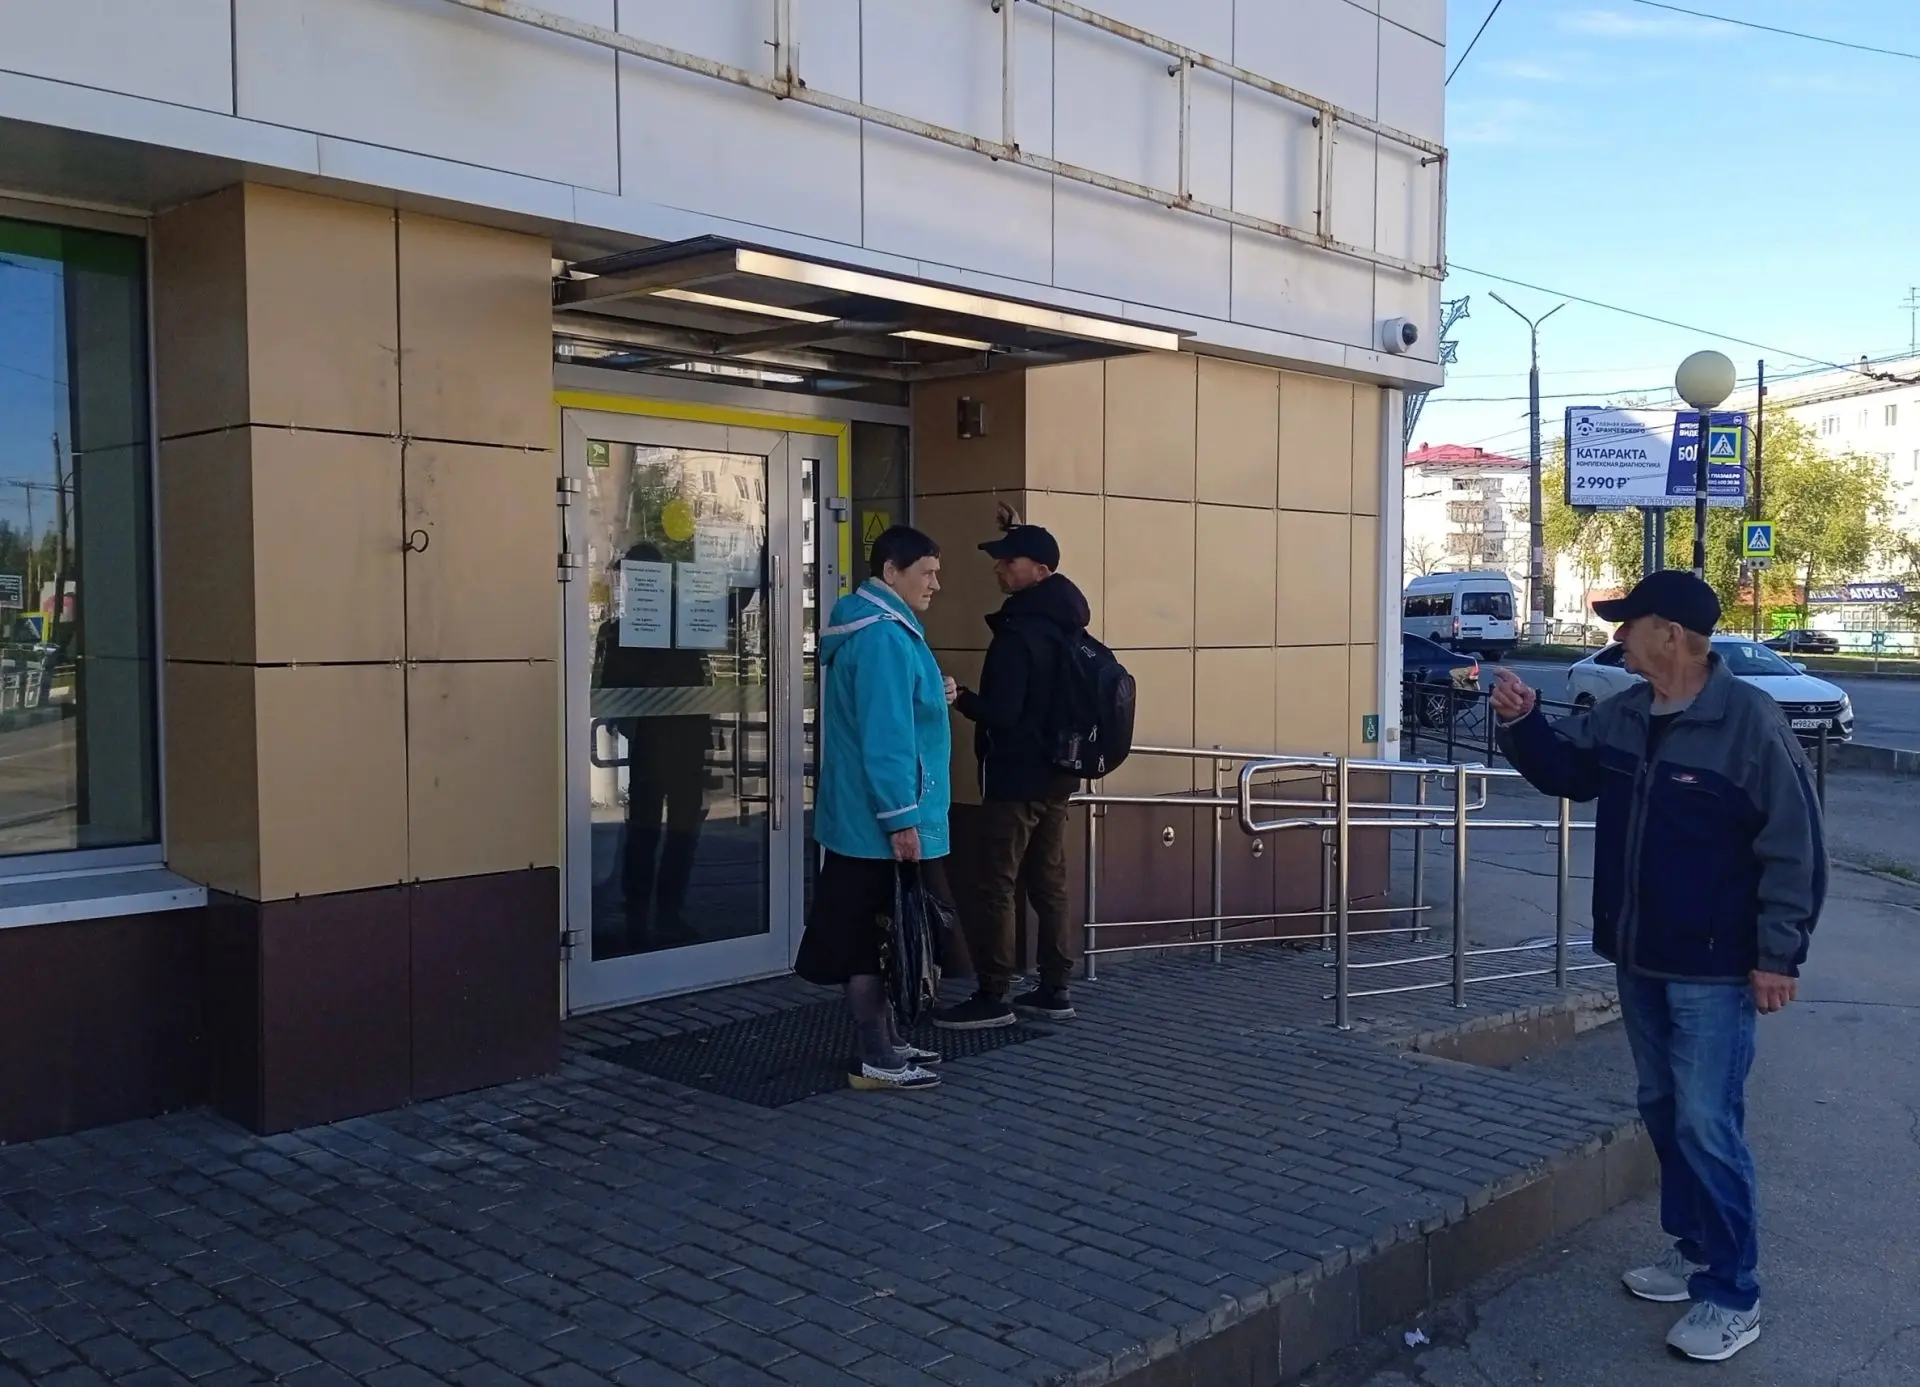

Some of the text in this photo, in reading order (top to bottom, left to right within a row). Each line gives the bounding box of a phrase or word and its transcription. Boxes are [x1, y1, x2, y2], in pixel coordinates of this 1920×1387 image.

[1679, 429, 1699, 437] ВИДЕ
[1577, 448, 1647, 460] КАТАРАКТА
[1678, 443, 1699, 461] БОЛ
[1576, 460, 1661, 469] КОМПЛЕКСНАЯ ДИАГНОСТИКА
[1849, 588, 1898, 599] АПРЕЛЬ
